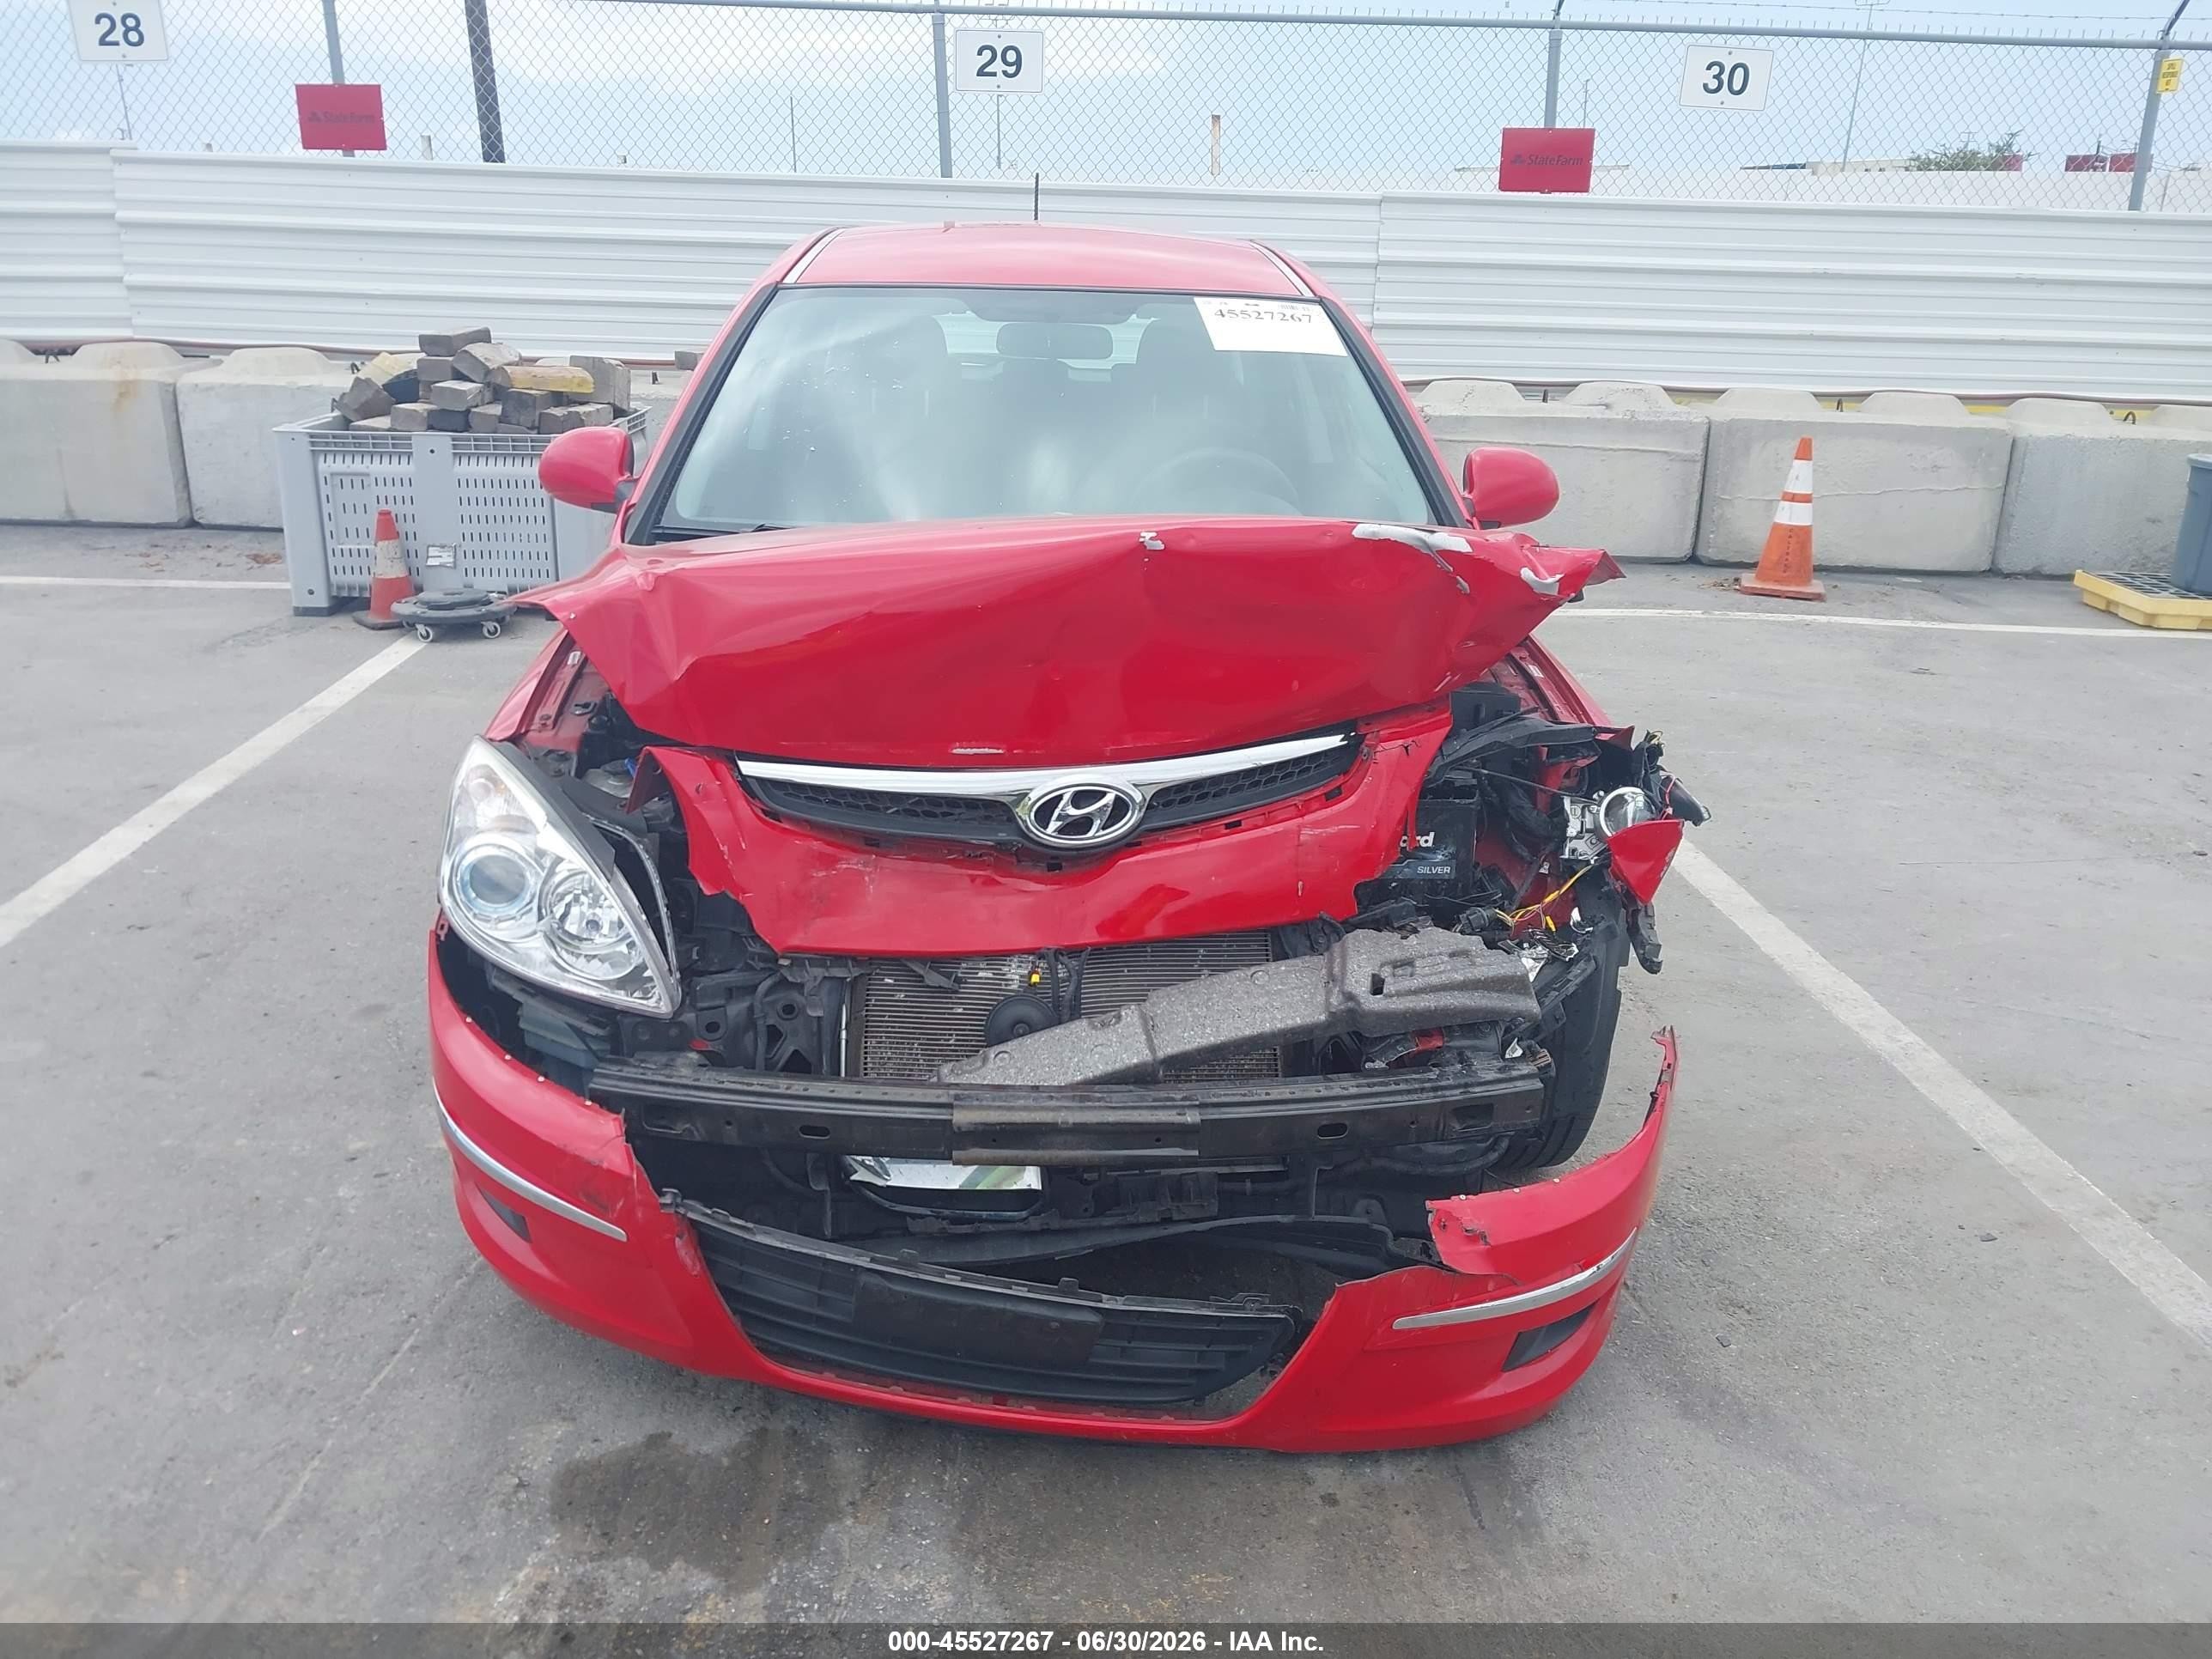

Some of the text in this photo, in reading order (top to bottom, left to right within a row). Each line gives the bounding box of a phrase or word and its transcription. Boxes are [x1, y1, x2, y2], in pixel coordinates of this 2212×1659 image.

[95, 14, 145, 47] 28
[976, 46, 1023, 79] 29
[1703, 61, 1750, 96] 30
[1214, 309, 1311, 324] 45527267
[1417, 866, 1451, 874] SILVER
